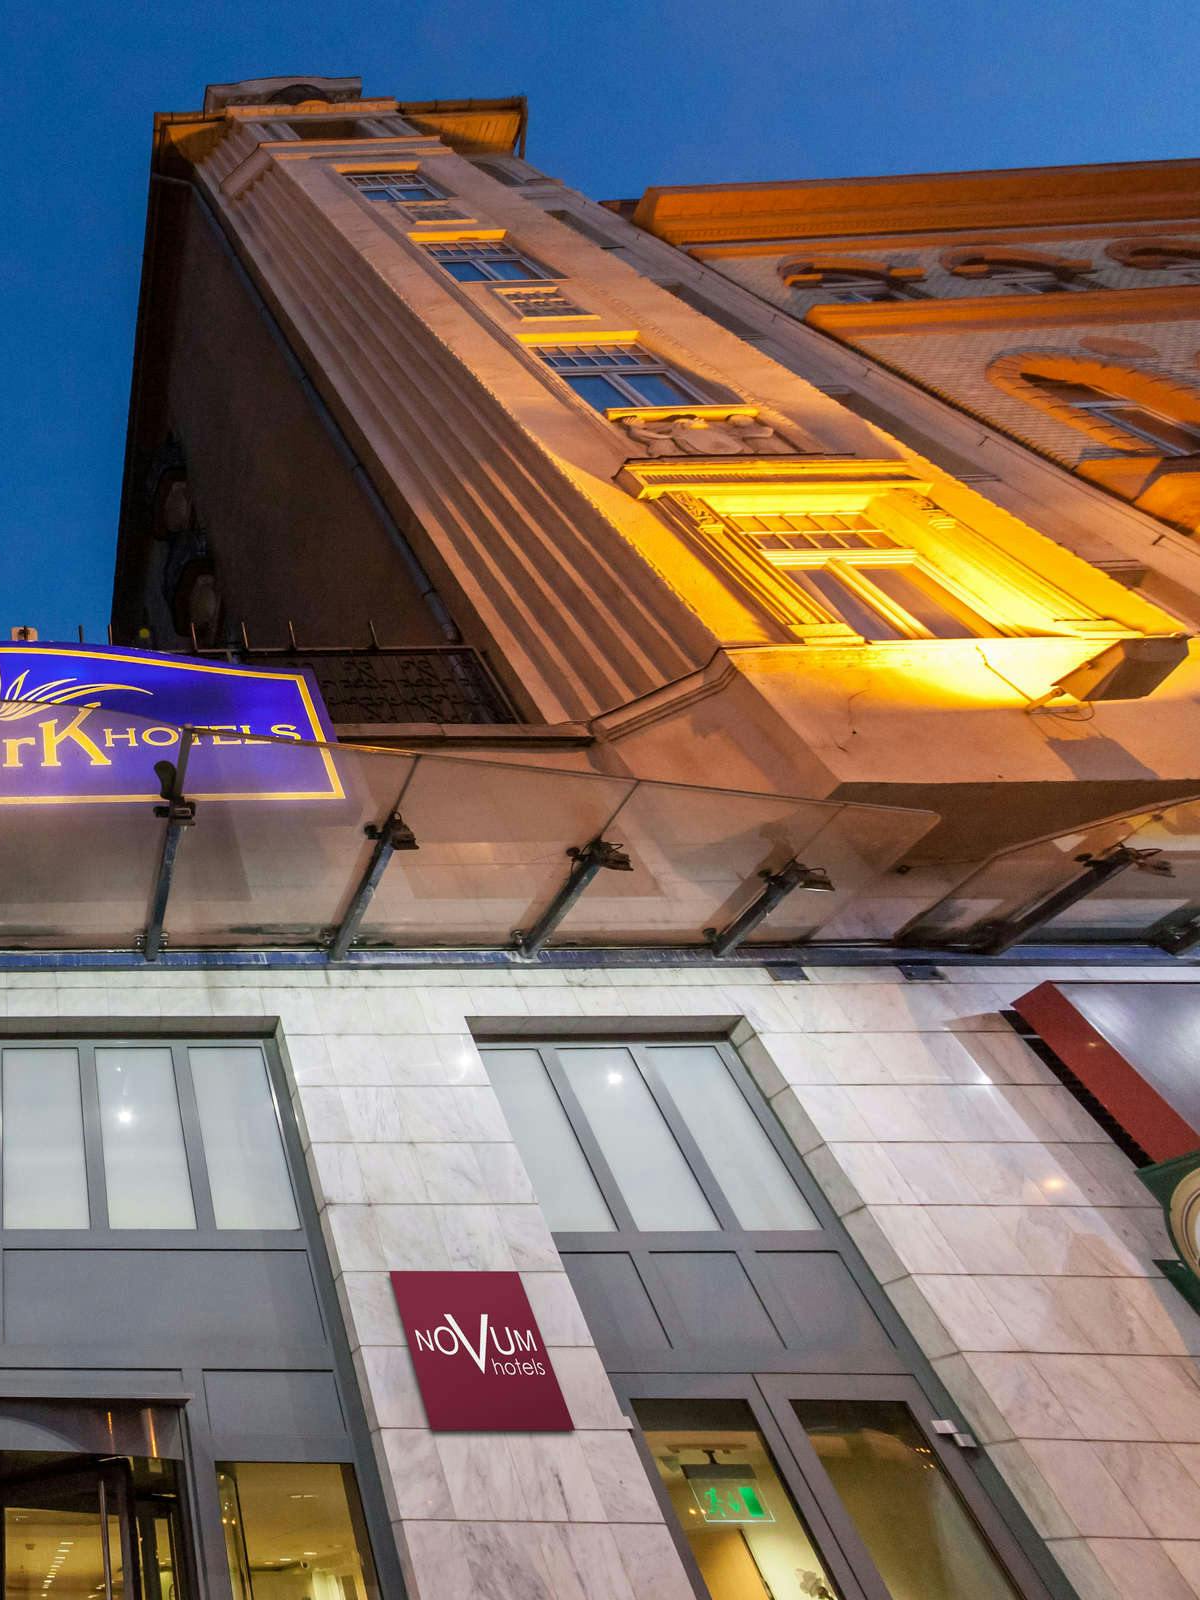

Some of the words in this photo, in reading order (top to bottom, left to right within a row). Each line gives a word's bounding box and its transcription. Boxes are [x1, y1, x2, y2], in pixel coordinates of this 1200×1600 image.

[104, 724, 302, 748] HOTELS
[414, 1314, 538, 1374] NOVUM
[491, 1358, 546, 1375] hotels
